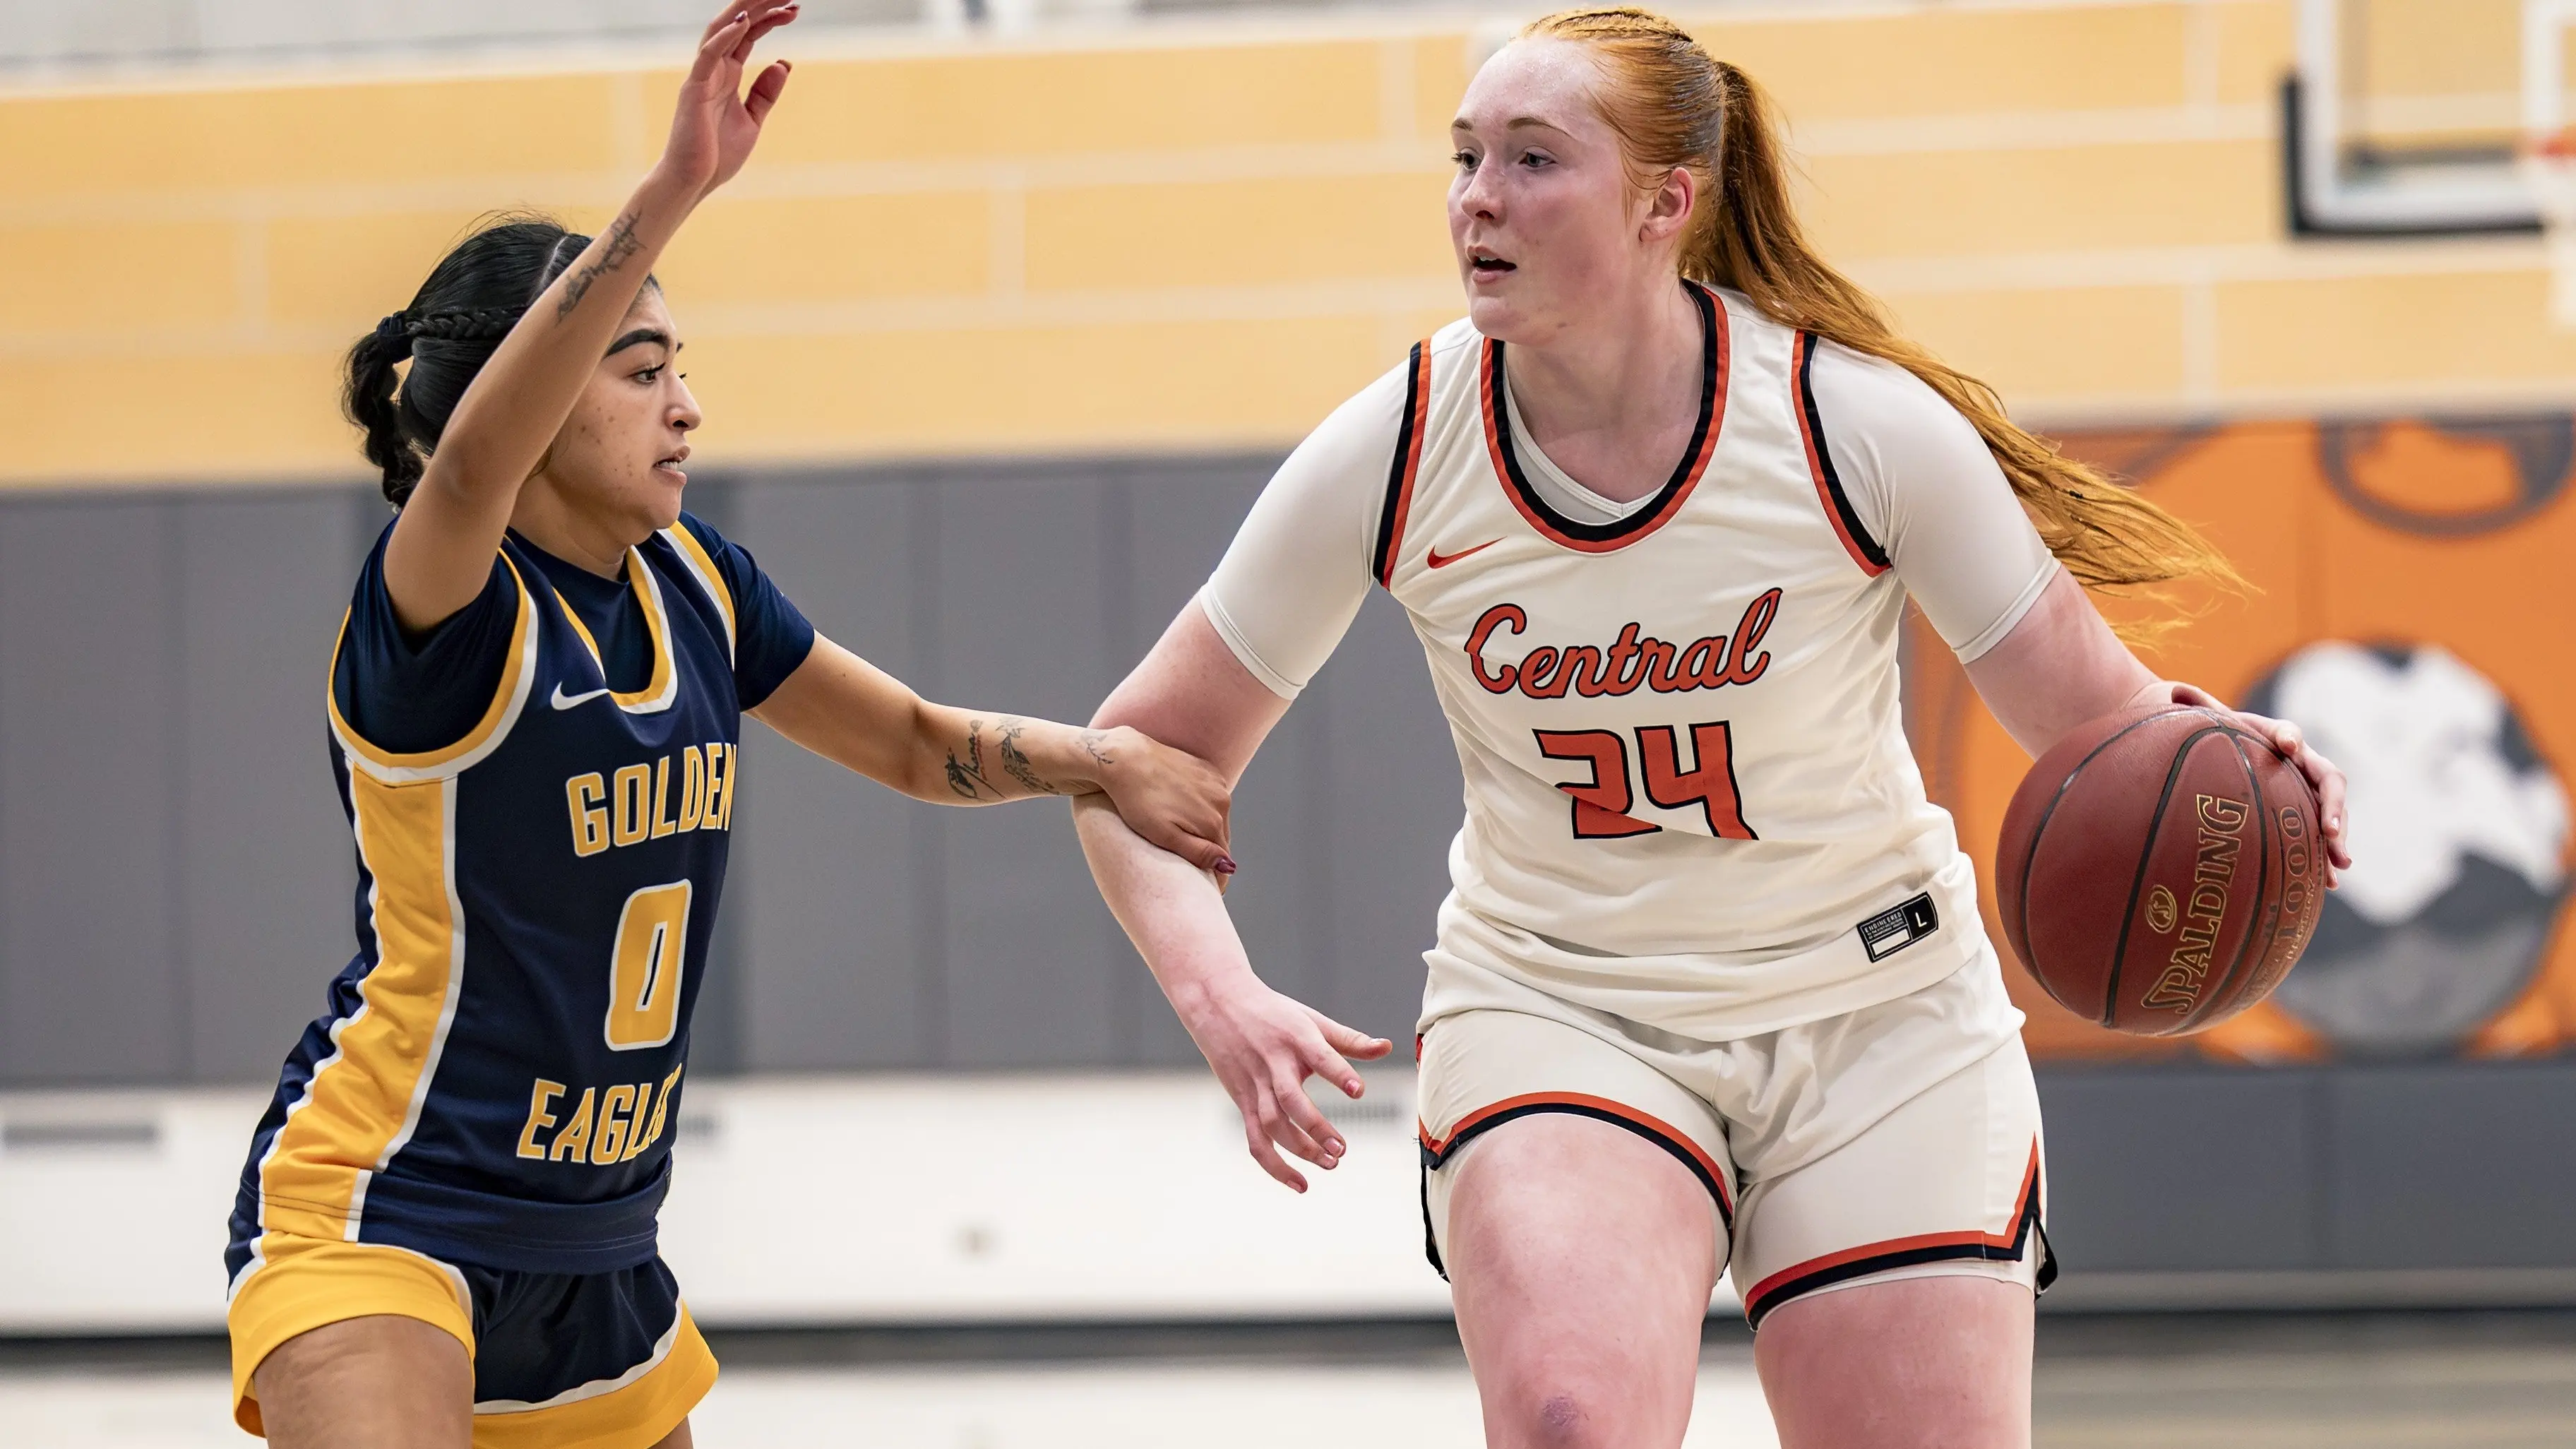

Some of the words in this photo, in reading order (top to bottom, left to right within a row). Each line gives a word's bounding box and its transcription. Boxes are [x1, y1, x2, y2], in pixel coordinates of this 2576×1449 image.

[1464, 588, 1783, 699] Central
[566, 742, 737, 858] GOLDEN
[1532, 720, 1760, 841] 24
[1914, 912, 1928, 928] L
[2140, 794, 2250, 1015] SPALDING
[604, 878, 692, 1051] 0
